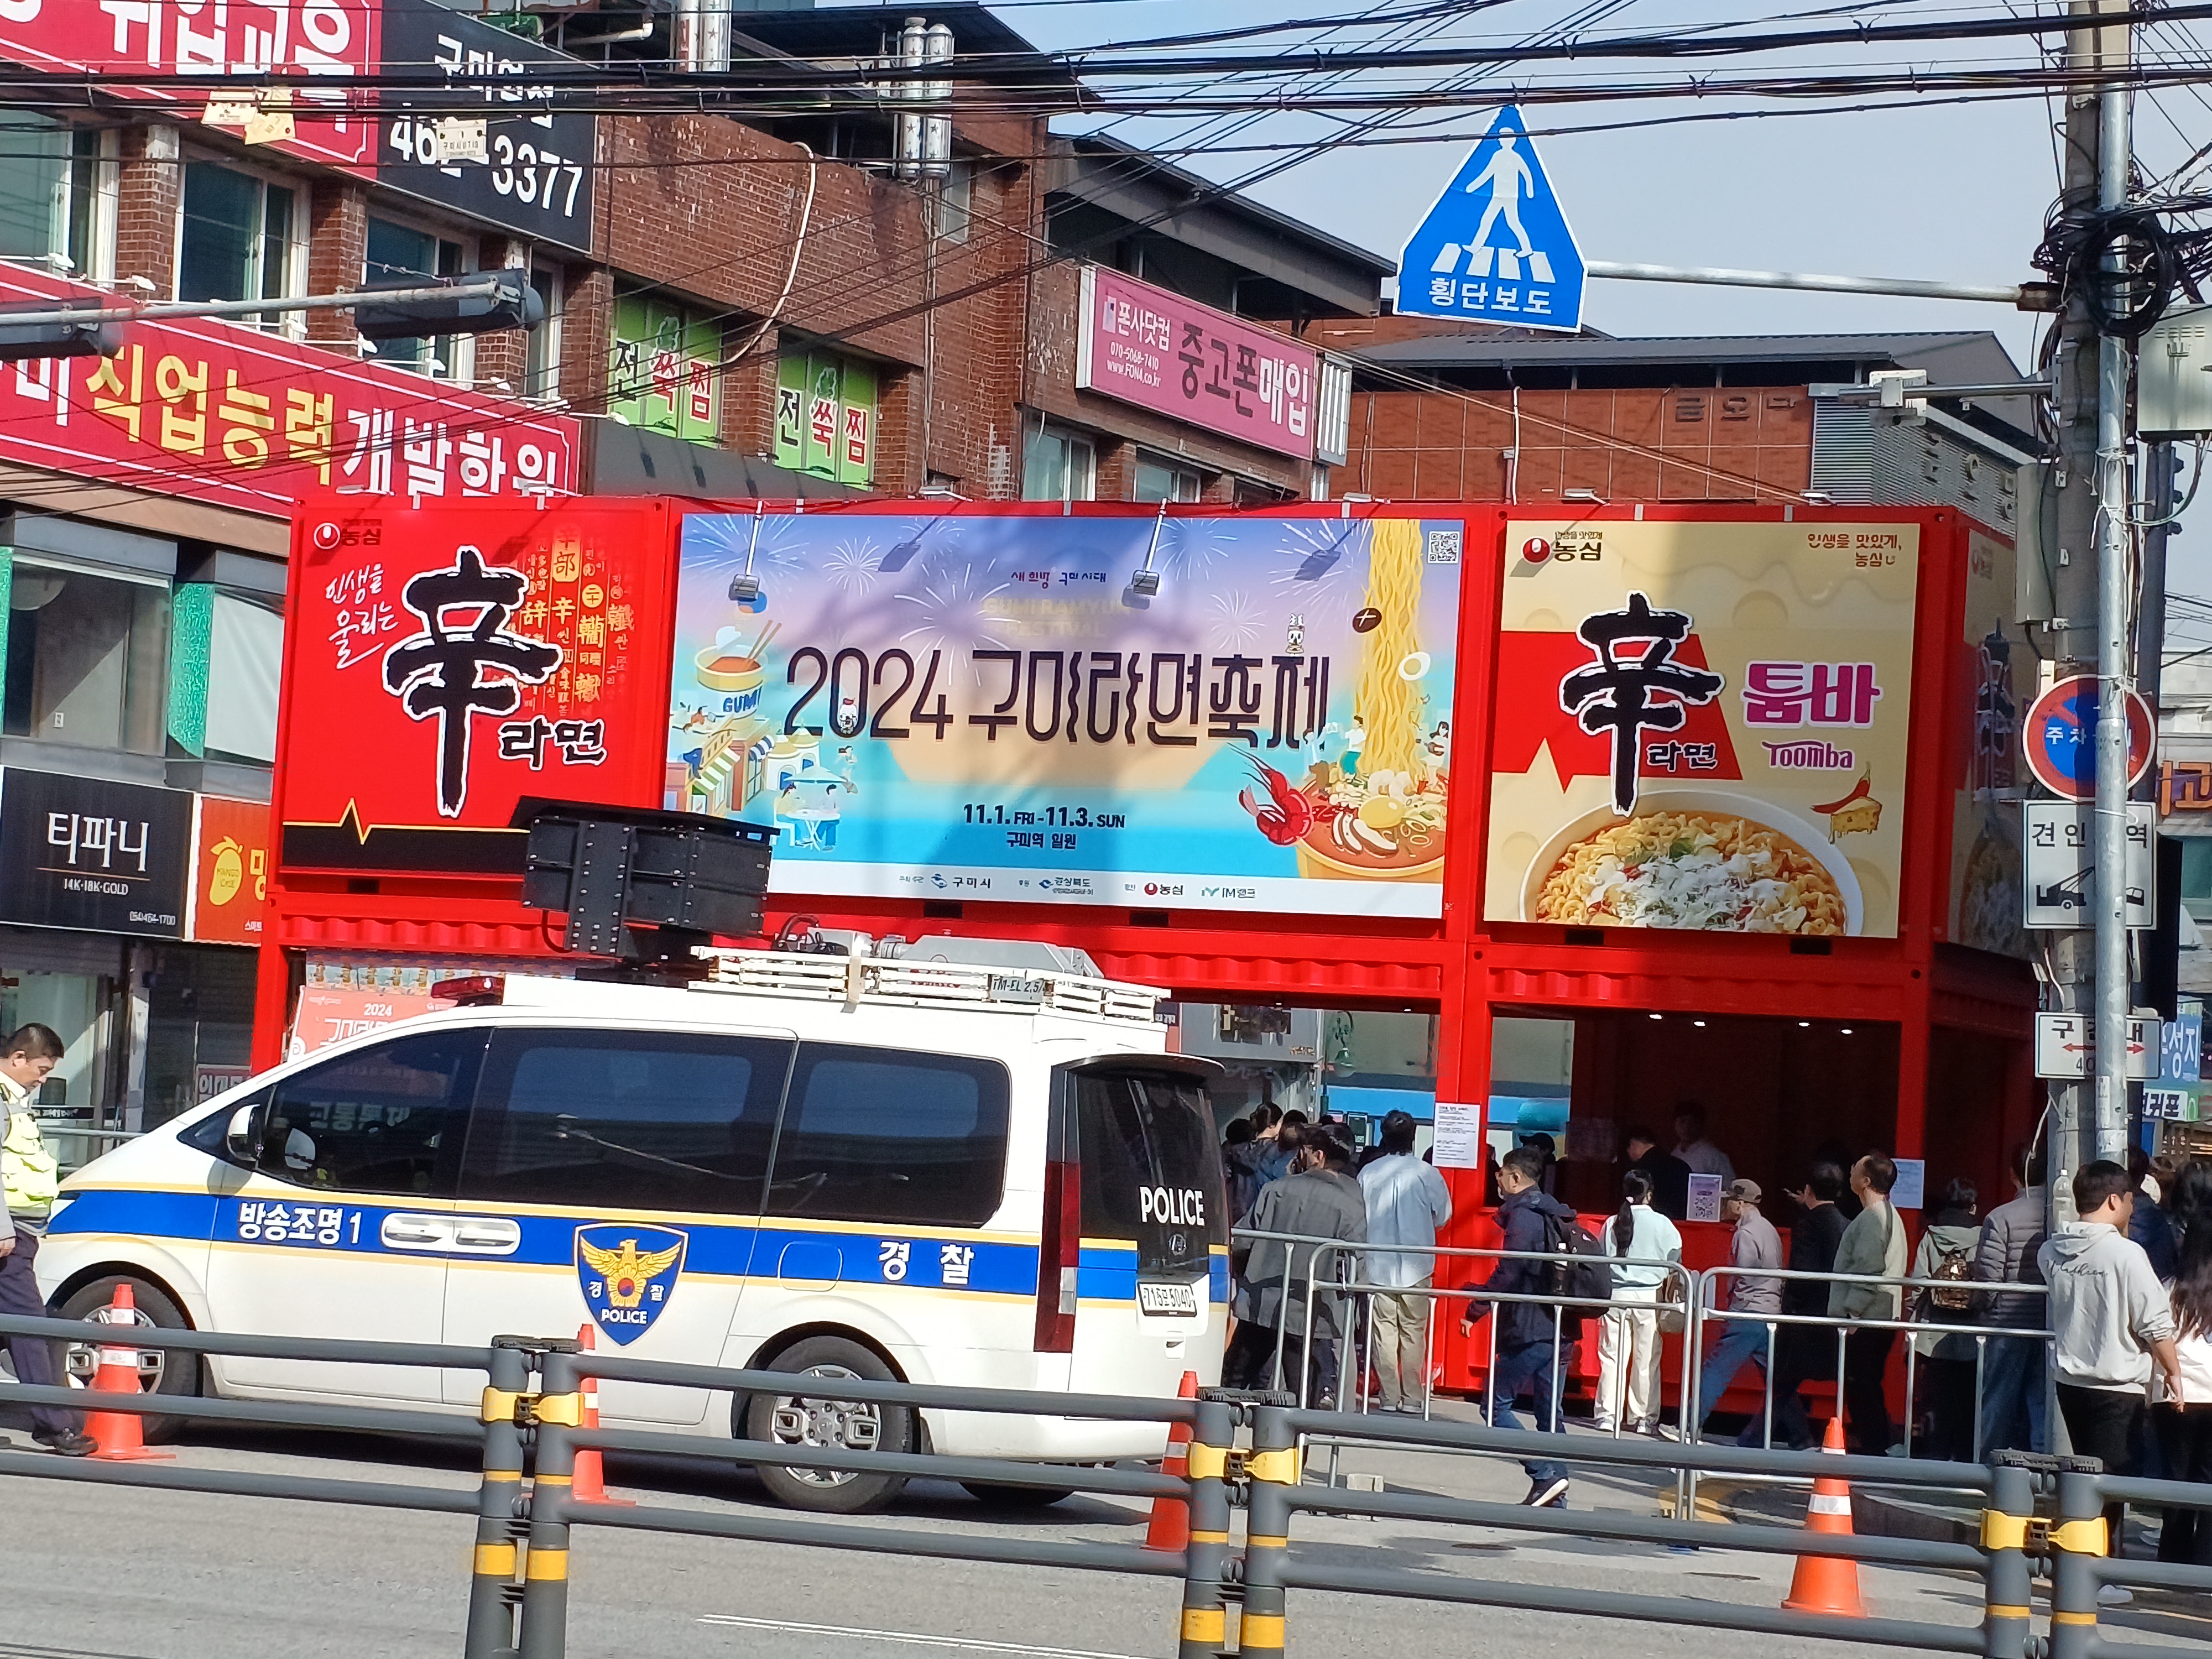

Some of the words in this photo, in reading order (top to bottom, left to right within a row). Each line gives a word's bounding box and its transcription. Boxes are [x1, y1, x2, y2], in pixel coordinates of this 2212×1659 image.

[1429, 278, 1552, 315] 횡단보도
[1117, 301, 1171, 352] 폰사닷컴
[341, 528, 382, 546] 농심
[1552, 542, 1602, 562] 농심
[1808, 534, 1850, 549] 인생을
[1855, 552, 1882, 567] 농심
[325, 563, 384, 604] 인생을
[383, 545, 563, 817] 辛
[784, 646, 954, 742] 2024
[1741, 661, 1882, 728] 툼바
[723, 682, 762, 712] GUMI
[1559, 590, 1725, 816] 辛
[498, 716, 607, 770] 라면
[1646, 740, 1718, 771] 라면
[1762, 739, 1854, 770] Toomba
[1096, 814, 1125, 828] SUN
[2032, 822, 2147, 848] 견인역
[48, 812, 149, 872] 티파니
[1006, 832, 1044, 848] 구미역
[1051, 833, 1076, 849] 일원
[952, 878, 990, 889] 구미시
[1159, 884, 1183, 895] 농심
[363, 1003, 393, 1017] 2024
[1139, 1186, 1206, 1227] POLICE
[601, 1308, 648, 1324] POLICE
